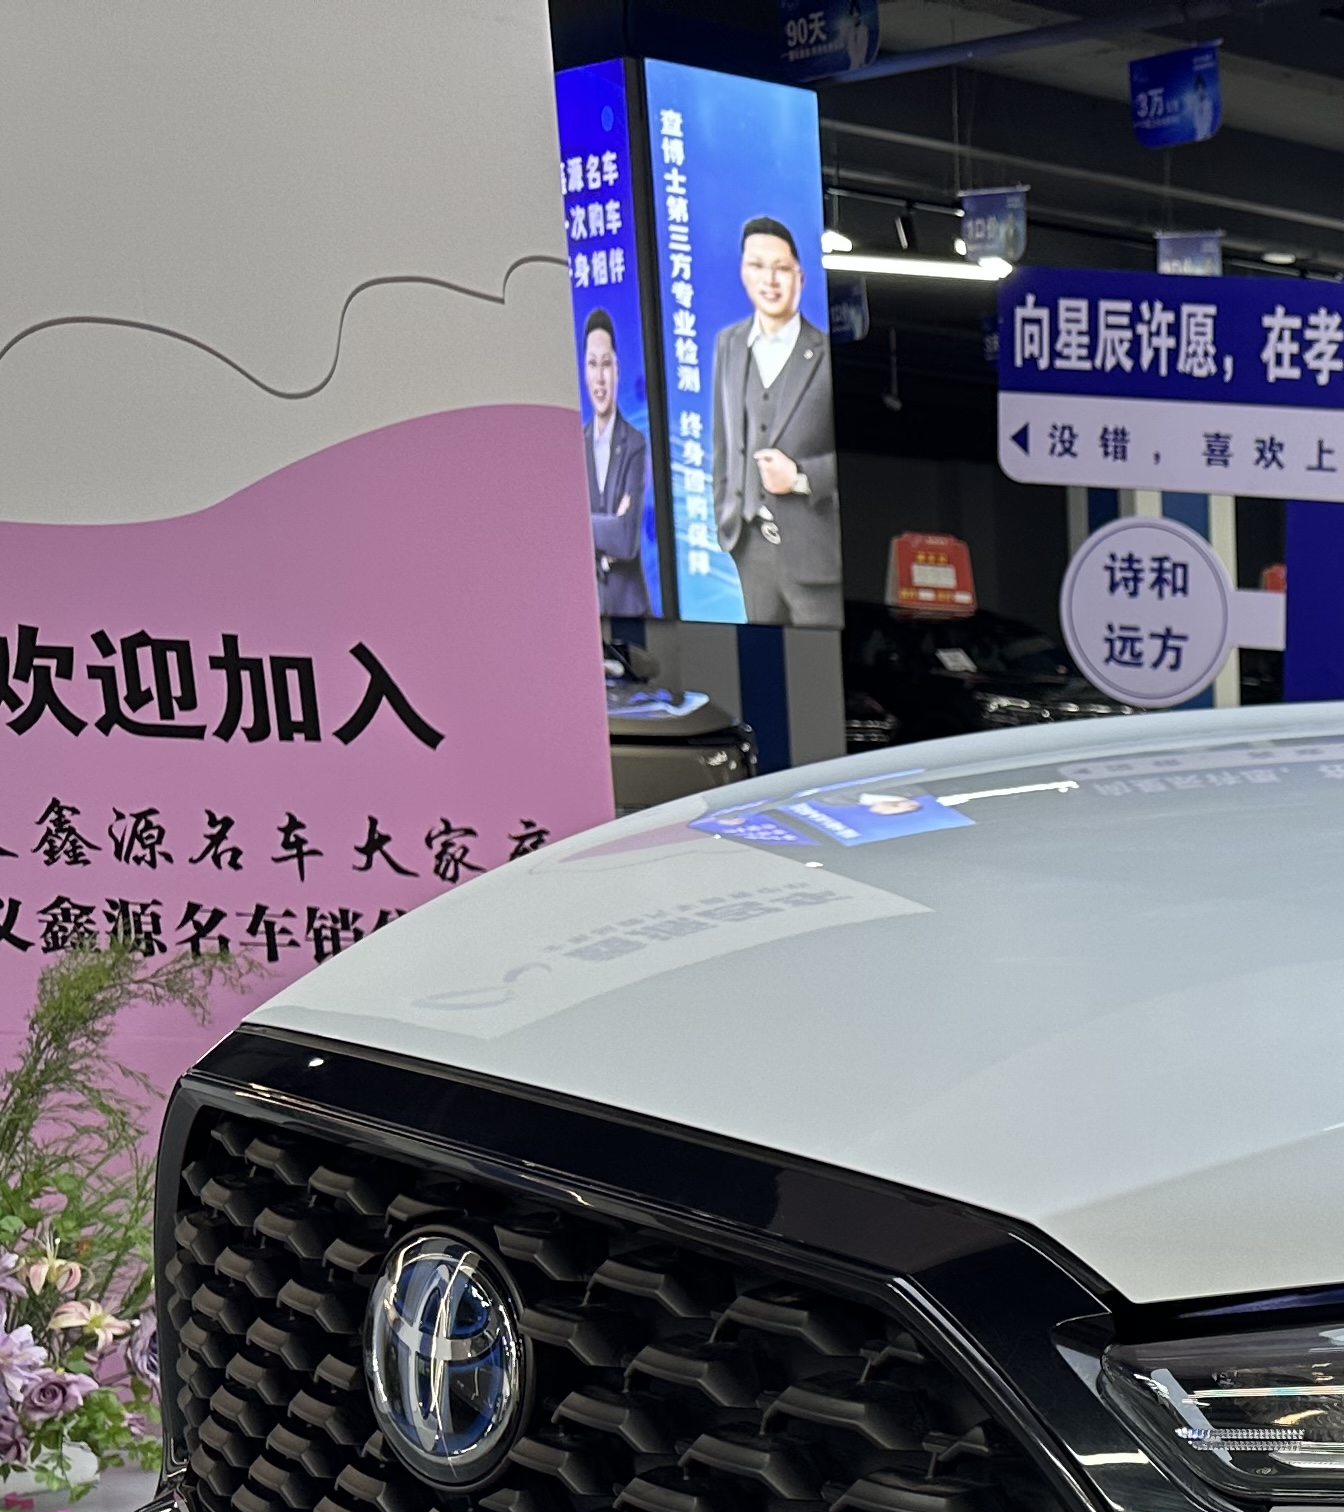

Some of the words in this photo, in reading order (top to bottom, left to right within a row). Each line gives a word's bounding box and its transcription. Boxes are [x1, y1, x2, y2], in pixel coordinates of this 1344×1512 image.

[786, 11, 827, 47] 90天
[564, 199, 622, 241] 次购车
[568, 247, 626, 288] 身相伴
[1103, 551, 1190, 600] 诗和
[1103, 626, 1190, 672] 远方
[0, 623, 446, 751] 欢迎加入
[0, 797, 551, 883] 鑫源名车大家
[0, 895, 408, 964] 义鑫源名车销
